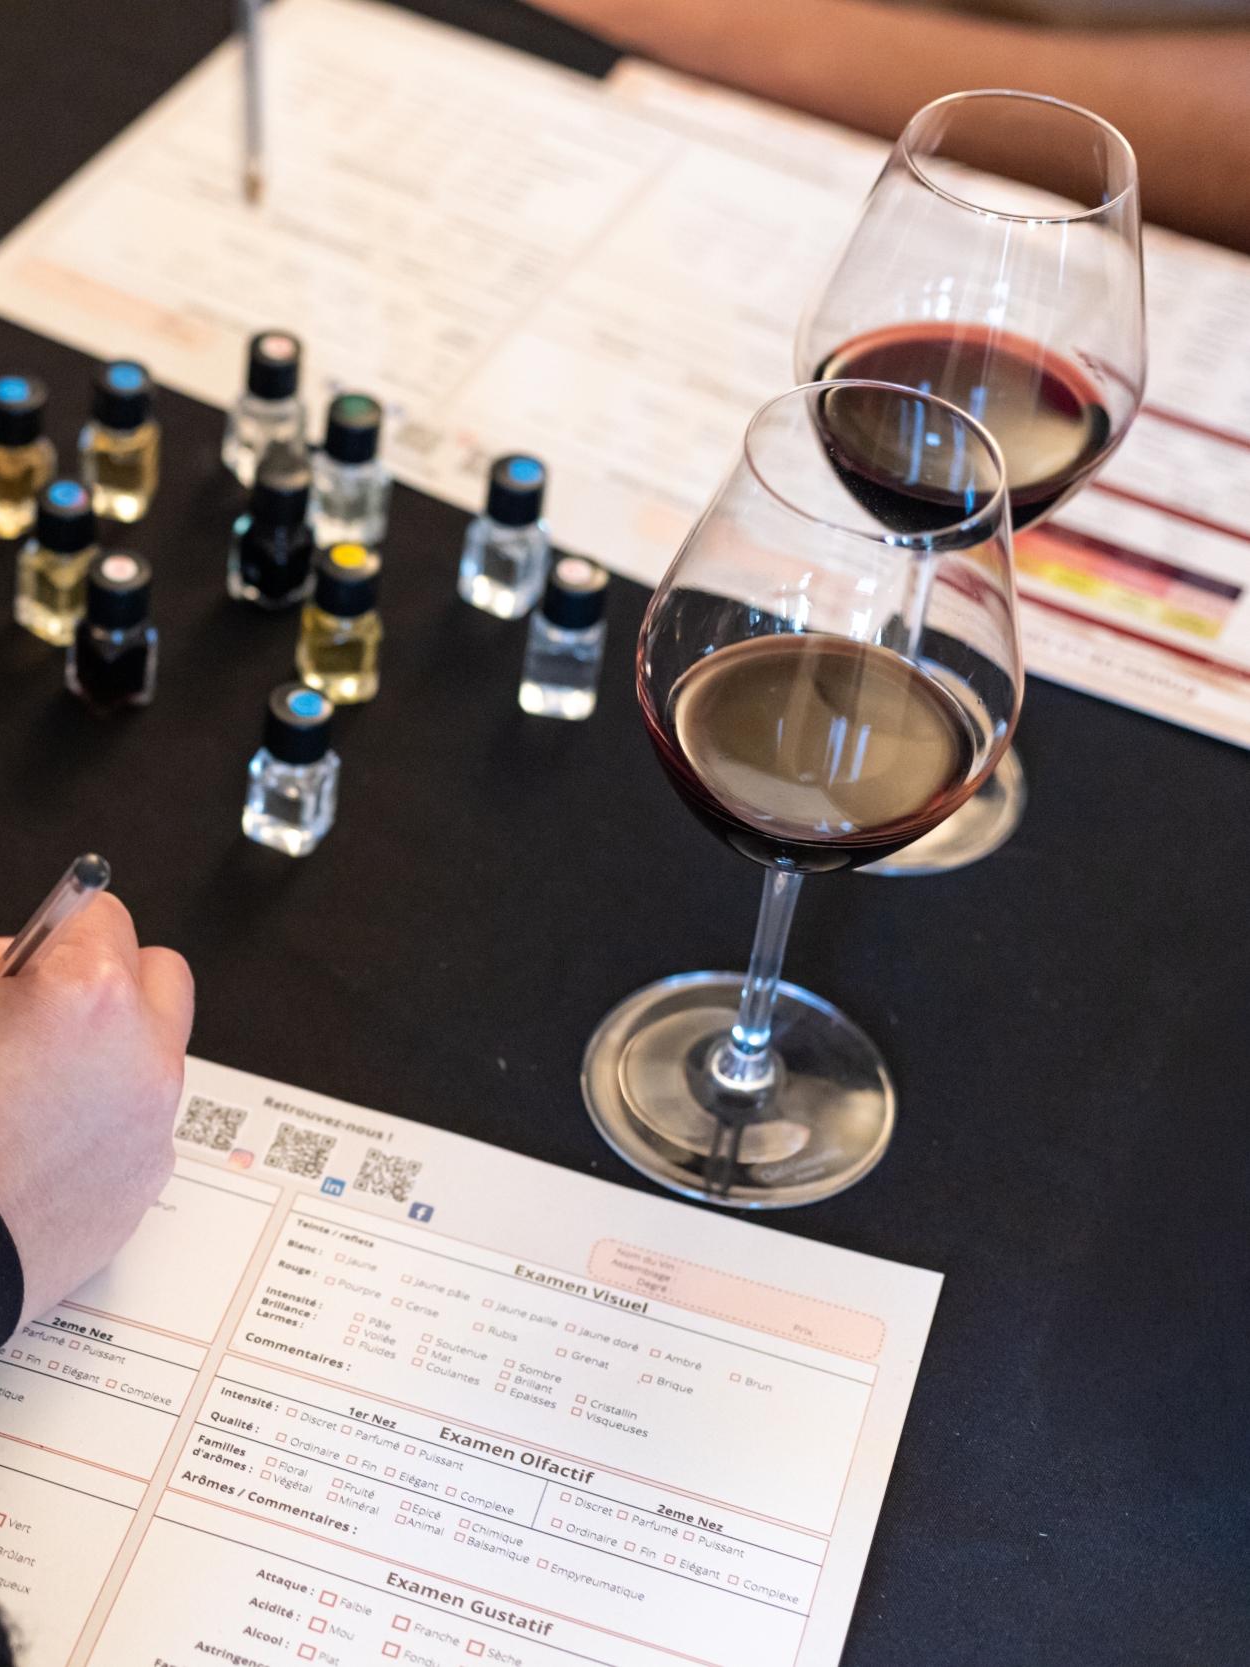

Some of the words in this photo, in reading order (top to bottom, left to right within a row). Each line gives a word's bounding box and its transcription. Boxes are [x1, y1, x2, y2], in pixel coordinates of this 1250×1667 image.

[297, 1218, 330, 1235] Teinte
[339, 1232, 375, 1248] reflets
[287, 1239, 316, 1254] Blanc
[446, 1288, 471, 1301] pâle
[612, 1338, 639, 1352] doré
[664, 1353, 702, 1371] Ambré
[744, 1376, 773, 1392] Brun
[514, 1264, 588, 1296] Examen
[593, 1287, 649, 1314] Visuel
[52, 1317, 88, 1333] 2eme
[89, 1327, 114, 1342] Nez
[81, 1343, 126, 1365] Puissant
[245, 1332, 344, 1369] Commentaires
[265, 1286, 317, 1308] Intensité
[368, 1317, 392, 1331] Pâle
[435, 1337, 489, 1361] Soutenue
[517, 1363, 563, 1384] Sombre
[277, 1259, 311, 1276] Rouge
[337, 1278, 382, 1299] Pourpre
[405, 1301, 440, 1319] Cerise
[487, 1325, 518, 1342] Rubis
[571, 1351, 610, 1370] Grenat
[656, 1376, 694, 1395] Brique
[25, 1353, 42, 1365] Fin
[61, 1364, 100, 1384] Elégant
[120, 1383, 172, 1407] Complexe
[256, 1307, 298, 1327] Larmes
[358, 1340, 396, 1360] Fluides
[425, 1362, 481, 1386] Coulantes
[509, 1387, 558, 1409] Epaisses
[586, 1411, 649, 1438] Visqueuses
[261, 1297, 311, 1318] Brillance
[364, 1329, 397, 1346] Voilée
[431, 1350, 453, 1364] Mat
[513, 1375, 553, 1395] Brillant
[590, 1399, 638, 1420] Cristallin
[220, 1386, 273, 1410] Intensité
[299, 1412, 338, 1432] Discret
[354, 1429, 401, 1451] Parfumé
[418, 1448, 464, 1472] Puissant
[348, 1407, 370, 1420] 1er
[371, 1413, 397, 1429] Nez
[210, 1411, 254, 1431] Qualité
[290, 1437, 341, 1461] Ordinaire
[360, 1459, 378, 1472] Fin
[398, 1471, 439, 1492] Elégant
[460, 1491, 515, 1516] Complexe
[439, 1426, 515, 1461] Examen
[520, 1452, 596, 1484] Olfactif
[181, 1470, 236, 1495] Arômes
[247, 1491, 350, 1532] Commentaires
[197, 1434, 247, 1457] Familles
[277, 1460, 309, 1478] Floral
[343, 1481, 375, 1500] Fruité
[411, 1503, 441, 1521] Epicé
[471, 1523, 524, 1547] Chimique
[656, 1504, 695, 1523] 2eme
[697, 1516, 724, 1533] Nez
[9, 1517, 32, 1534] Vert
[192, 1447, 247, 1472] d'arômes
[273, 1473, 313, 1494] Végétal
[338, 1495, 380, 1515] Minéral
[405, 1517, 445, 1537] Animal
[466, 1535, 530, 1565] Balsamique
[550, 1563, 645, 1602] Empyreumatique
[574, 1496, 614, 1517] Discret
[631, 1514, 679, 1537] Parfumé
[697, 1535, 745, 1559] Puissant
[565, 1523, 618, 1548] Ordinaire
[639, 1546, 657, 1559] Fin
[679, 1558, 721, 1580] Elégant
[743, 1579, 799, 1605] Complexe
[248, 1597, 294, 1619] Acidité
[328, 1623, 355, 1641] Mou
[255, 1569, 308, 1593] Attaque
[339, 1597, 373, 1617] Faible
[413, 1622, 461, 1647] Franche
[486, 1647, 523, 1667] Sèche
[386, 1571, 465, 1609] Examen
[470, 1601, 554, 1637] Gustatif
[242, 1625, 284, 1647] Alcool
